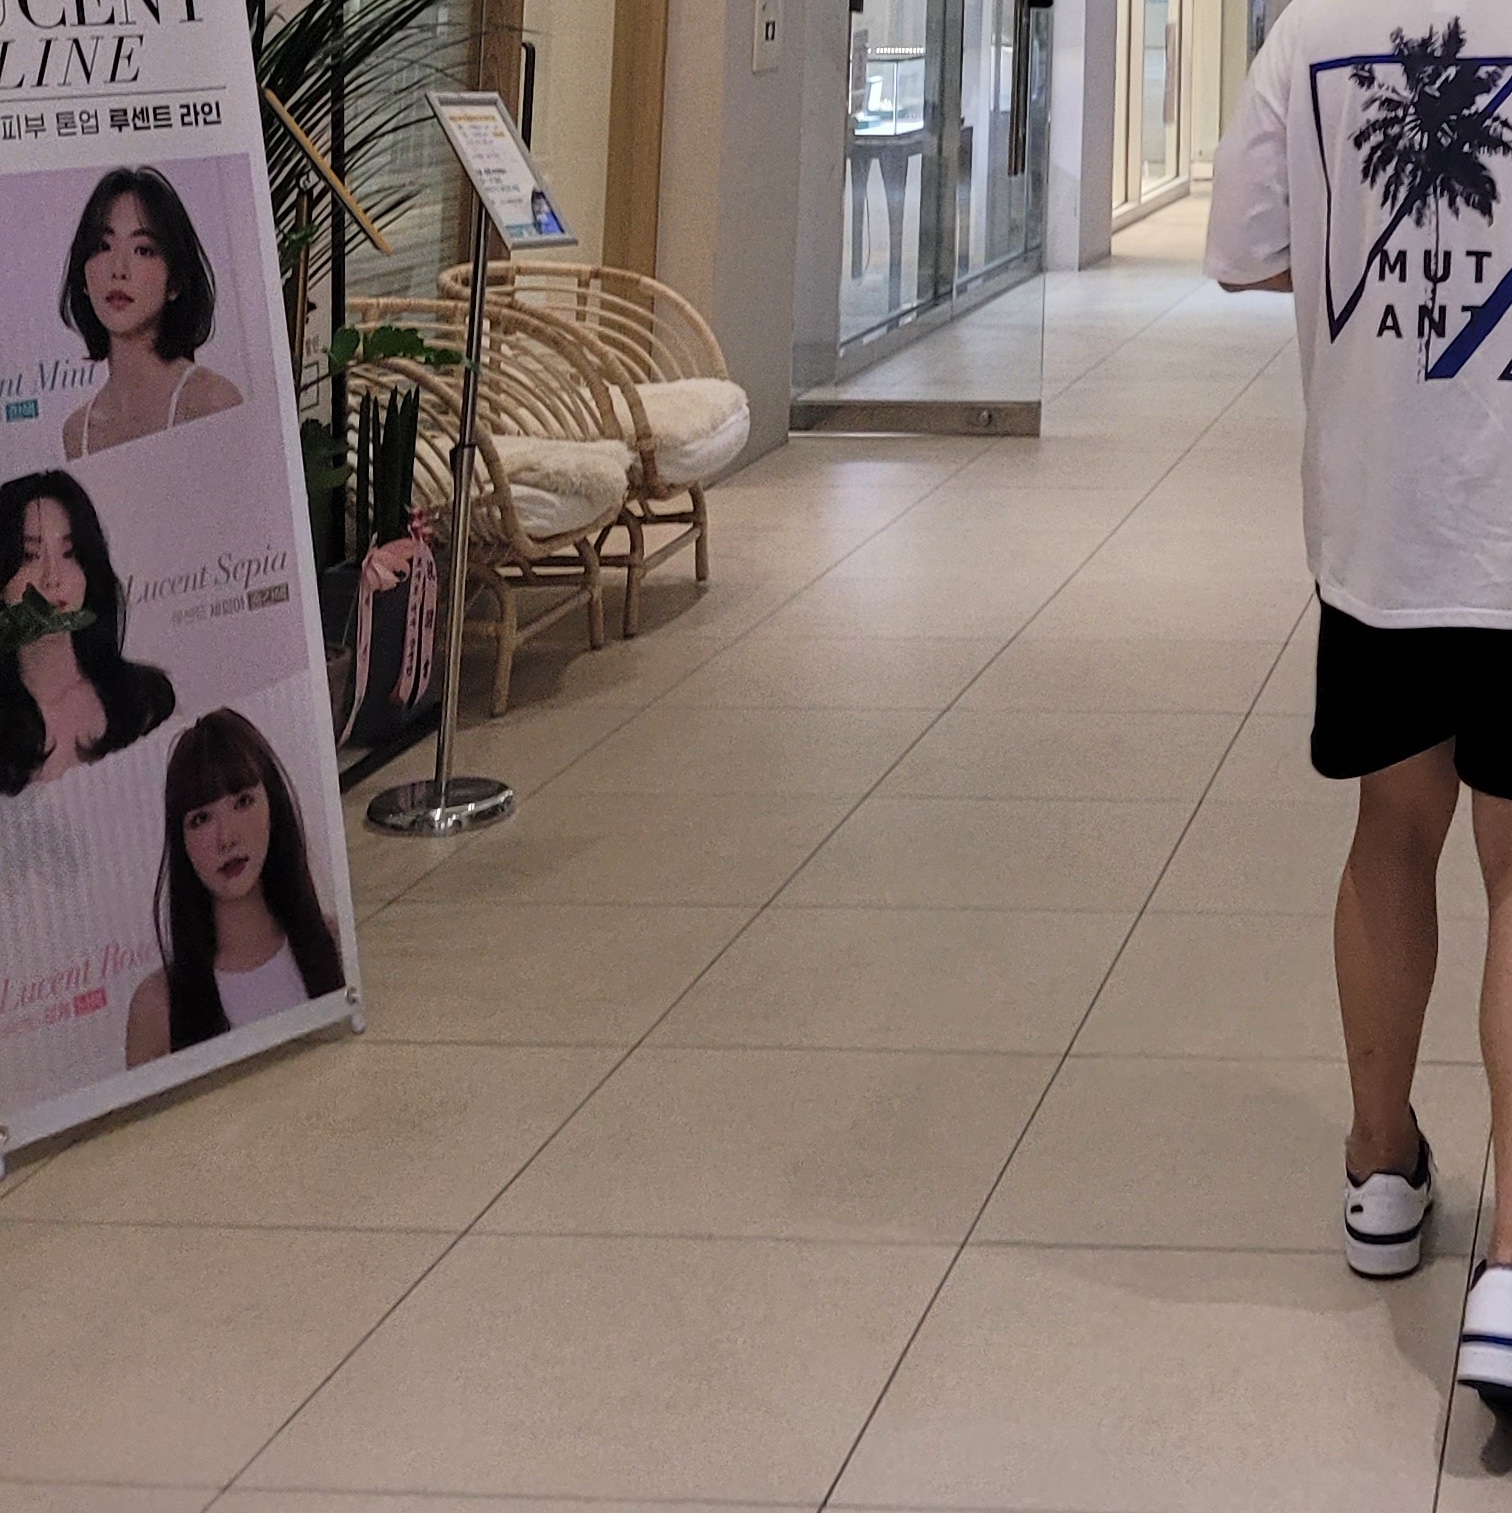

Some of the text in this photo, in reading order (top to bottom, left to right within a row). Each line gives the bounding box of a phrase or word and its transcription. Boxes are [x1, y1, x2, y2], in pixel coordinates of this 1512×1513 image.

[0, 34, 144, 88] LINE
[0, 100, 222, 140] 피부 톤업 루센트 라인
[1378, 248, 1493, 284] MUT
[39, 359, 95, 391] Mint
[125, 573, 207, 608] Lucent
[214, 543, 287, 592] Sepia
[0, 958, 90, 1014] Lucent
